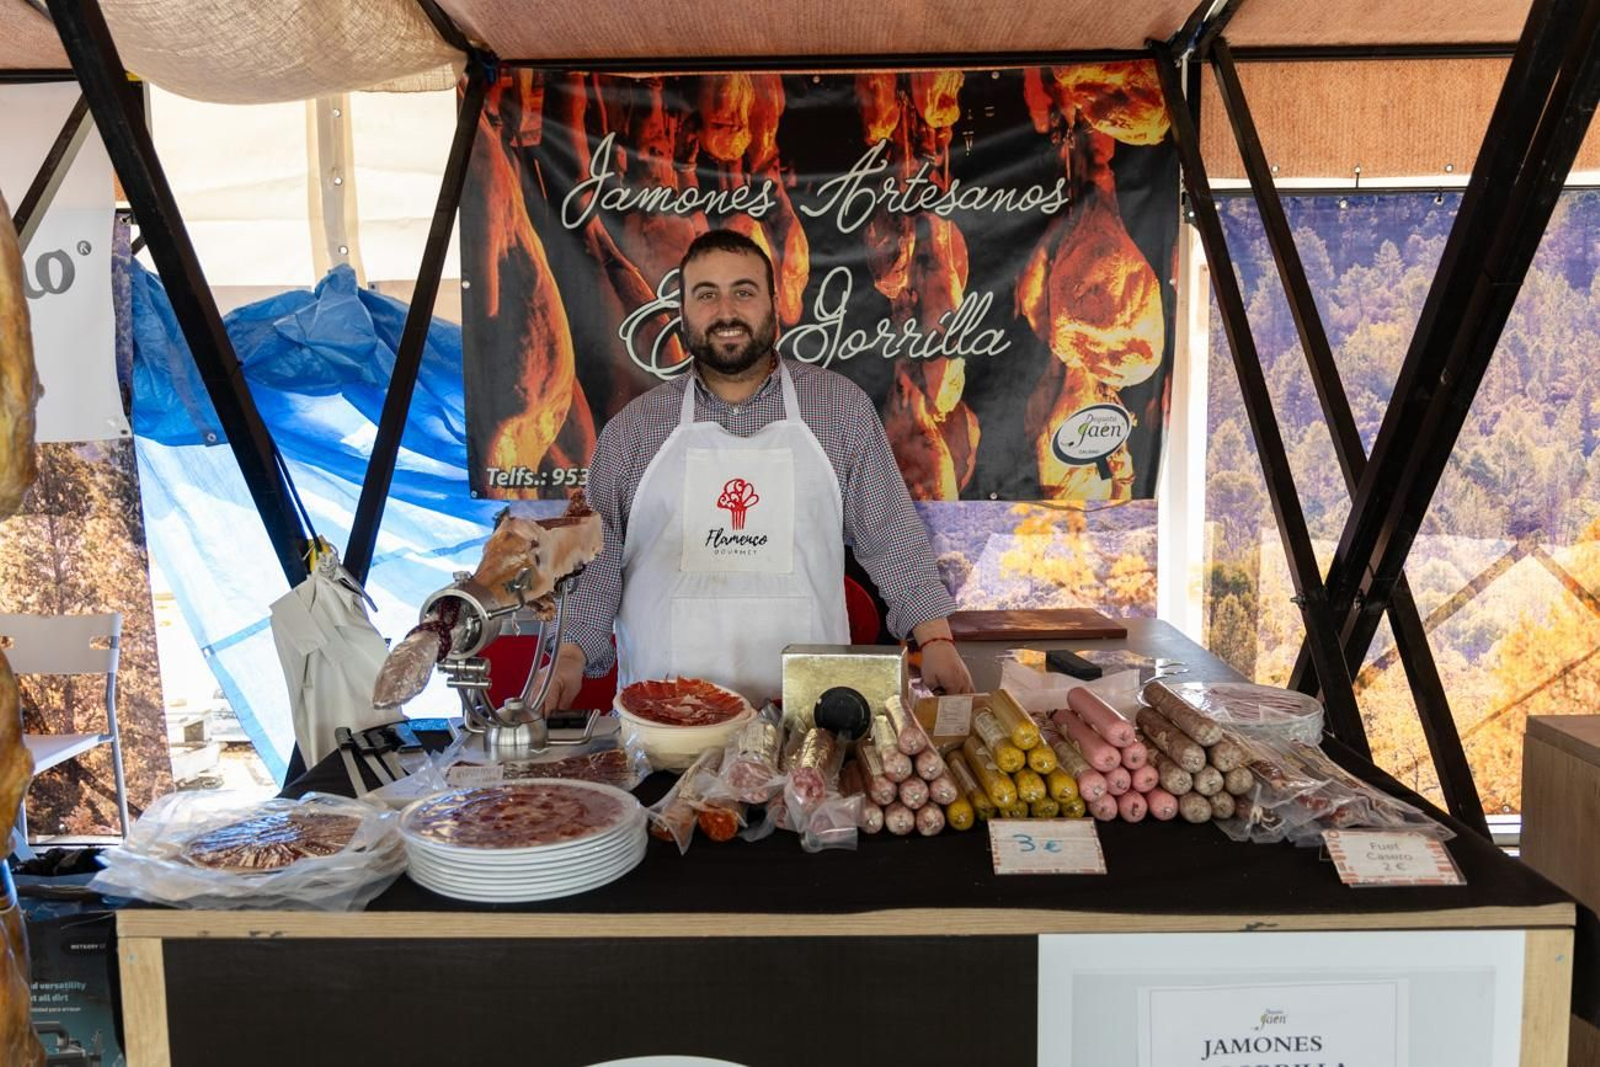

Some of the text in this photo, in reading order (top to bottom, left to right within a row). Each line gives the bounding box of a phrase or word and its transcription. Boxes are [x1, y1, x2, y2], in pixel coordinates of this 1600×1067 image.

[561, 131, 1070, 234] Jamones Artesanos
[776, 266, 1011, 371] Gorrilla
[486, 467, 548, 486] Telfs.:
[705, 528, 768, 548] Flamenco
[1013, 834, 1063, 853] 3 €
[1370, 842, 1399, 850] Fuet
[1366, 852, 1414, 861] Casero
[1382, 863, 1406, 871] 2 €
[39, 982, 87, 991] versatility
[38, 993, 51, 1002] all
[52, 993, 69, 1002] dirt
[1201, 1035, 1323, 1061] JAMONES
